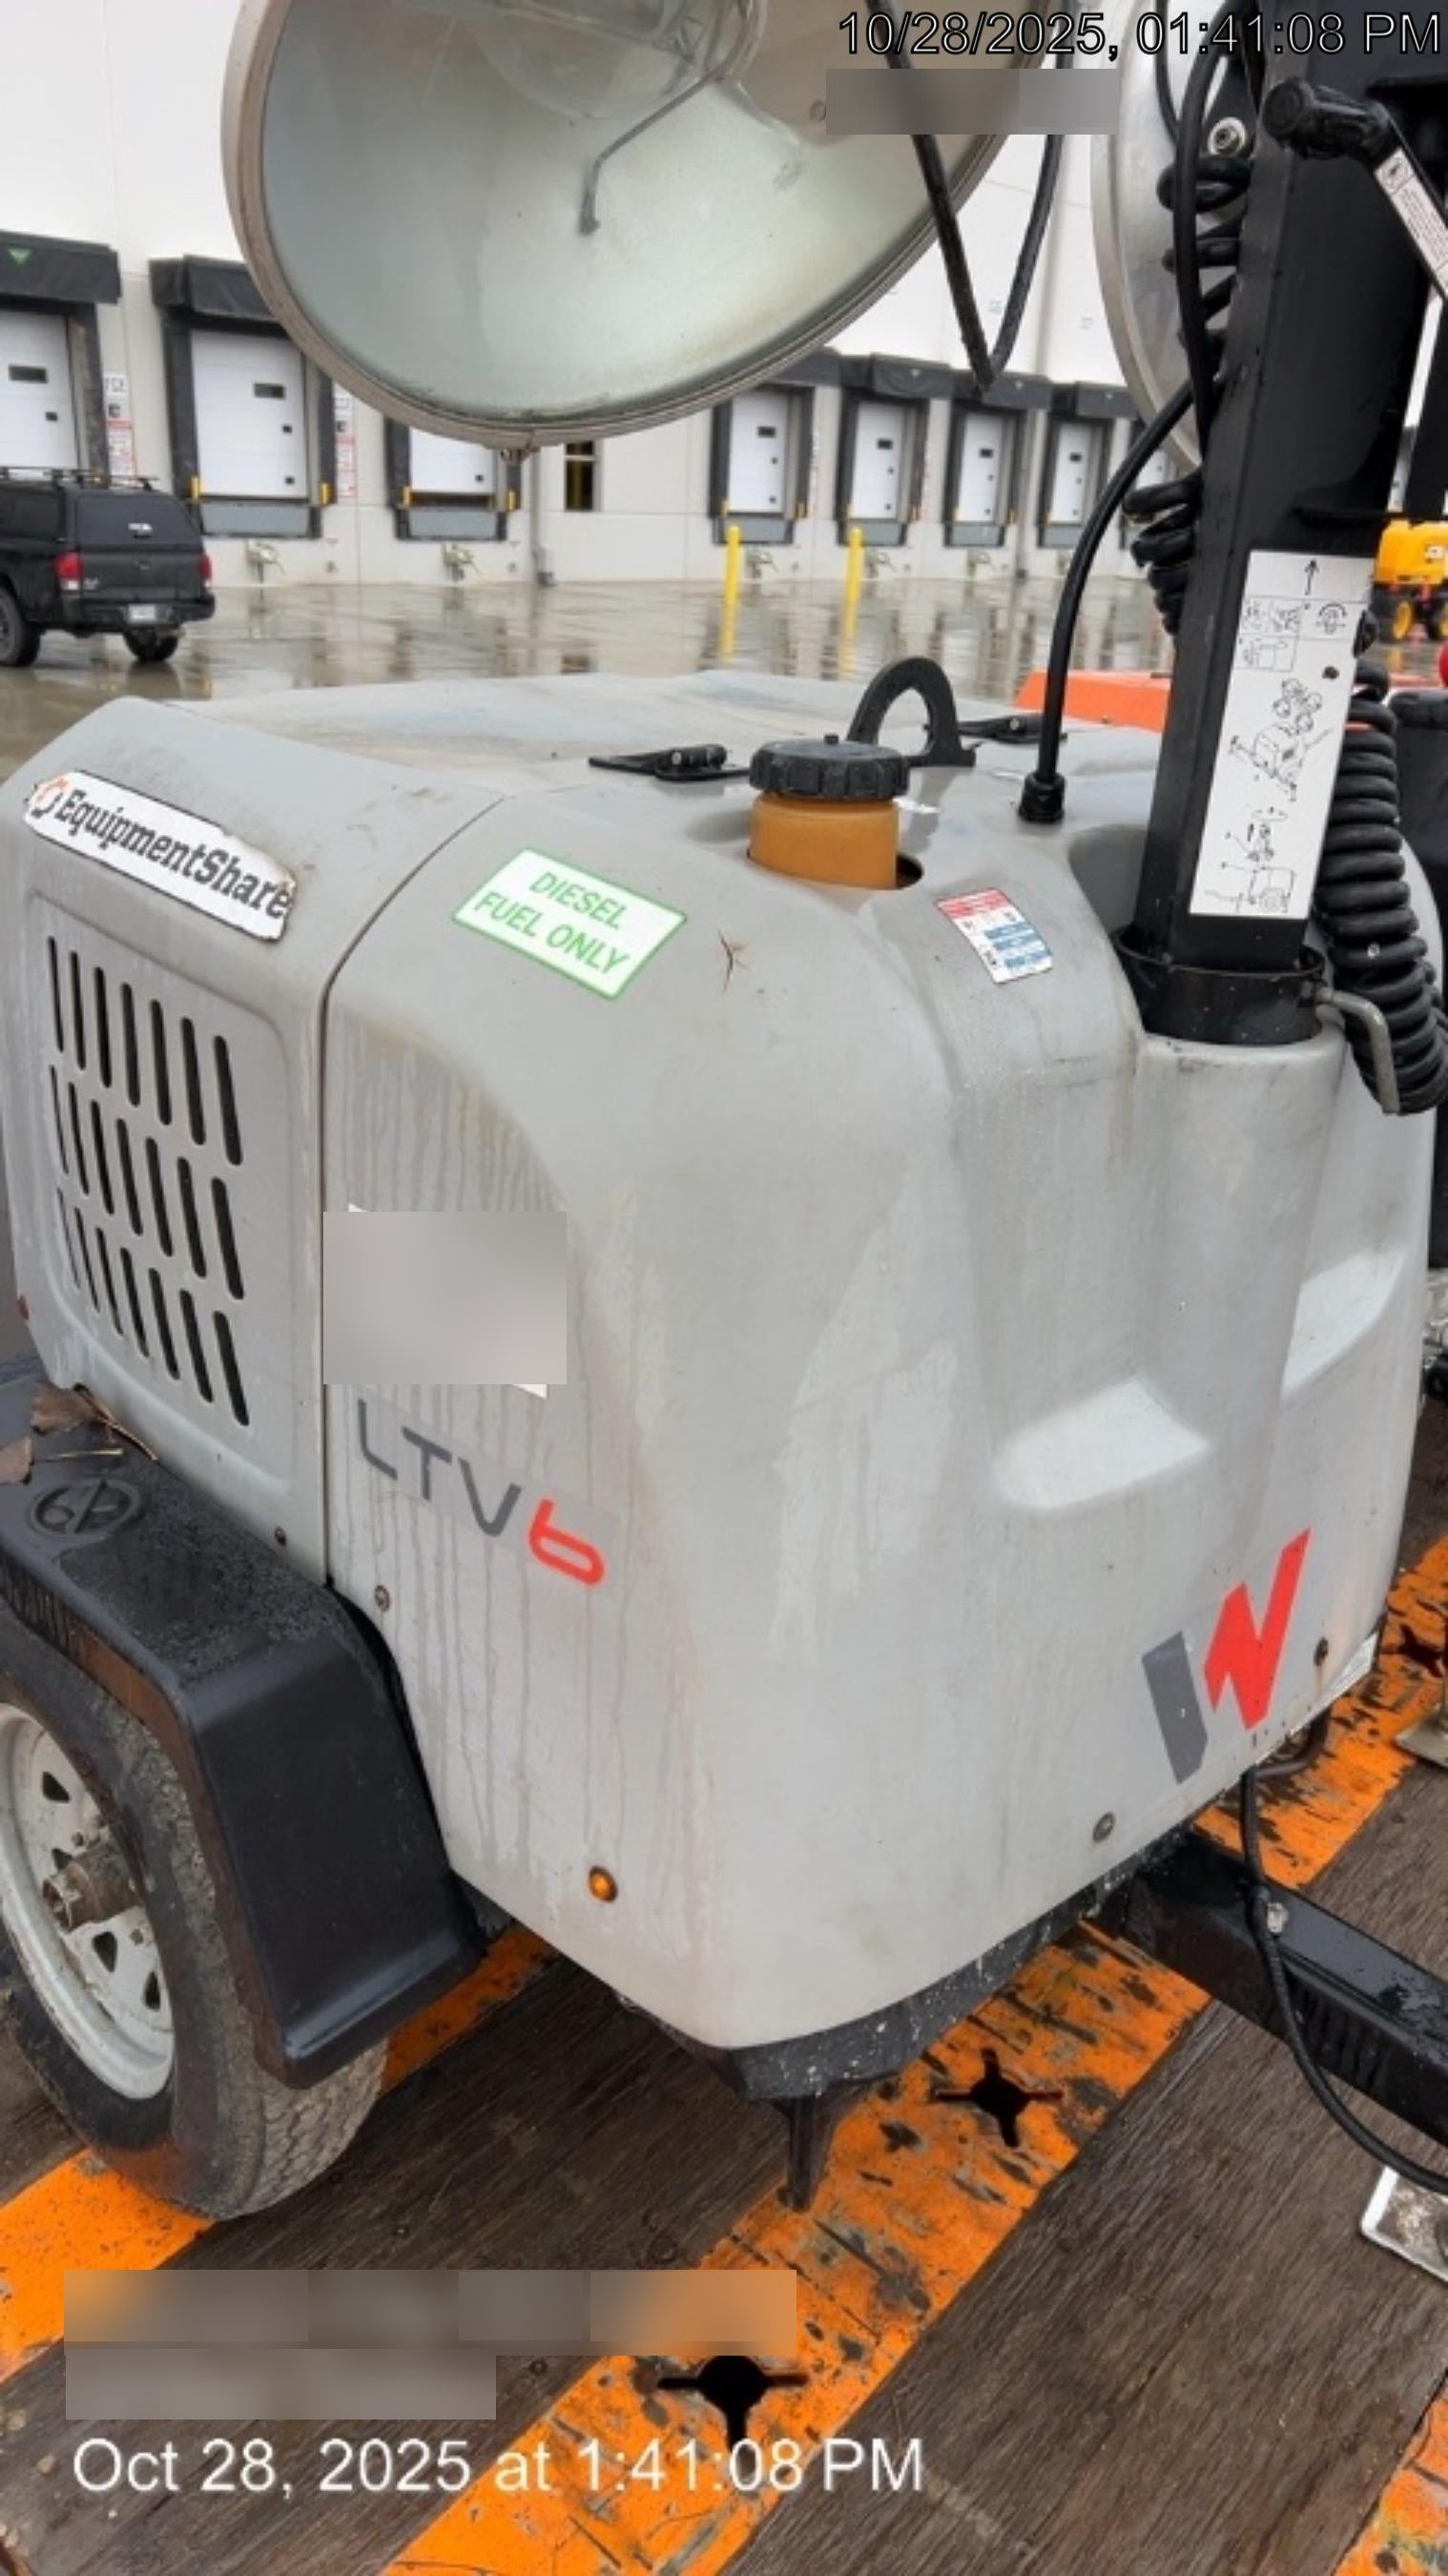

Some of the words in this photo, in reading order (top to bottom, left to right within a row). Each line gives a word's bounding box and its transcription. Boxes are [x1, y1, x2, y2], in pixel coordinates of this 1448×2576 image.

[53, 788, 292, 919] EquipmentShare
[474, 891, 544, 938] FUEL
[546, 923, 631, 975] ONLY
[528, 871, 627, 929] DIESEL
